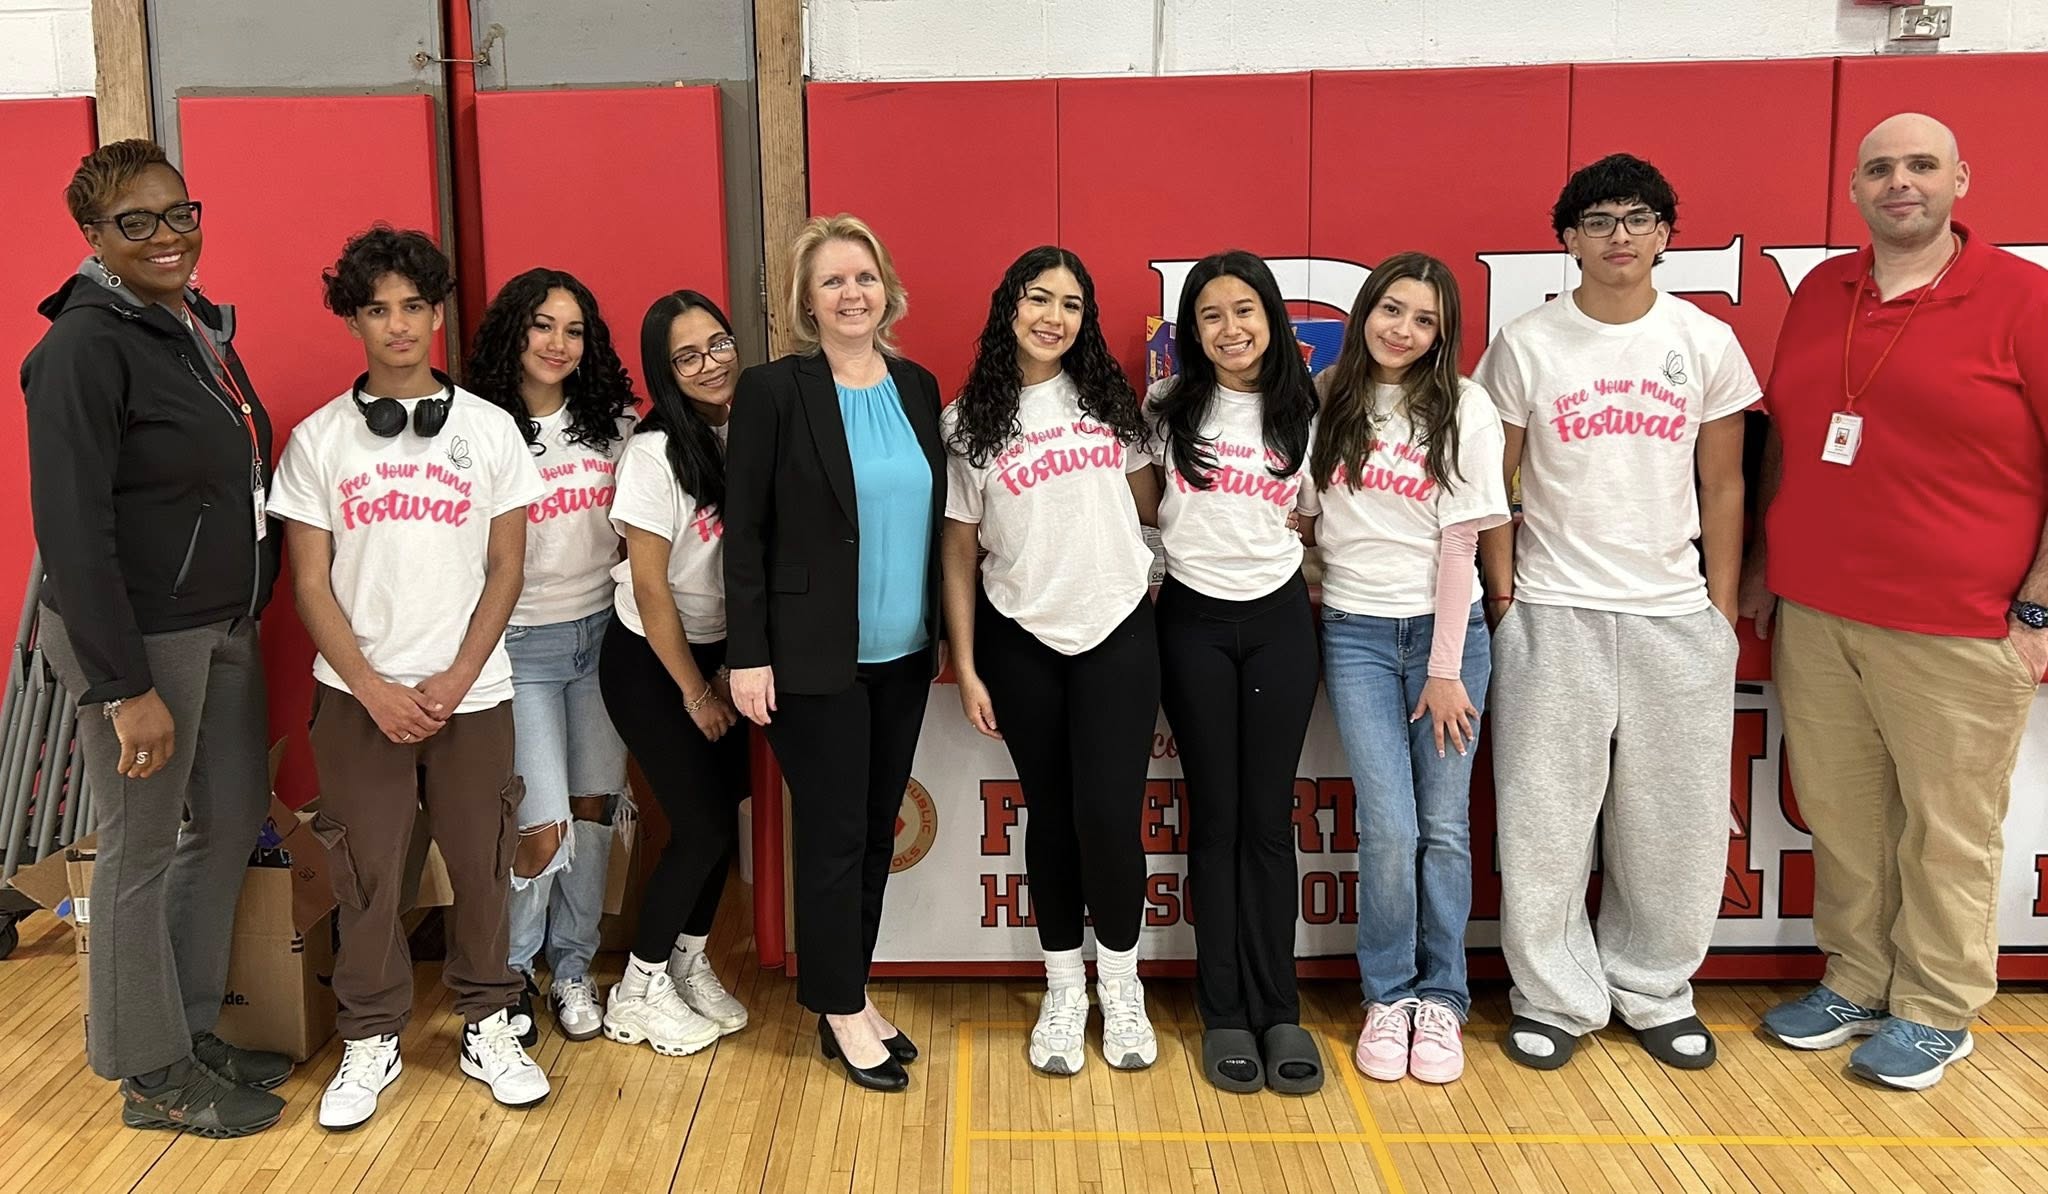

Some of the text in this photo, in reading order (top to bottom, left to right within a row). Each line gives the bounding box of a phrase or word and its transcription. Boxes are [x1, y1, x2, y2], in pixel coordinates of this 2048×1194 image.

[1552, 378, 1687, 414] Free Your Mind
[1549, 405, 1687, 443] Festival
[338, 462, 473, 499] Free Your Mind
[581, 458, 617, 476] Min
[997, 440, 1124, 496] Festival
[340, 489, 472, 530] Festival
[527, 486, 616, 524] estiva
